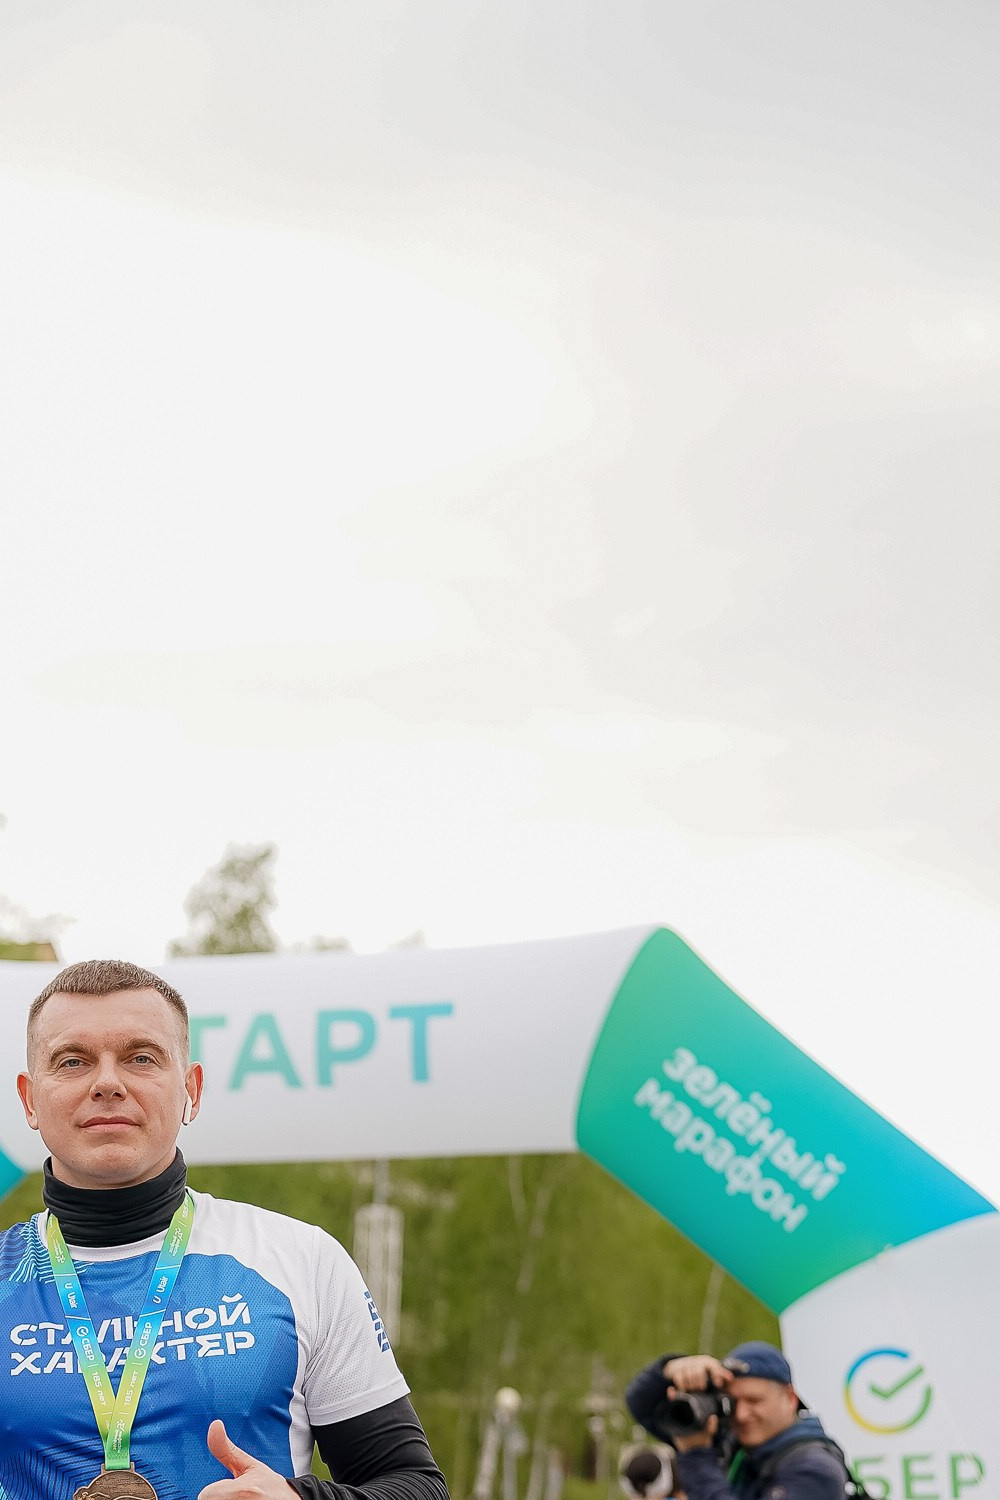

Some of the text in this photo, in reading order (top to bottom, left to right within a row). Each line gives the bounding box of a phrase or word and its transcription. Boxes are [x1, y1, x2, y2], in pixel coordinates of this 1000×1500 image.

[188, 1002, 455, 1092] ТАРТ
[661, 1046, 848, 1201] зелёный
[634, 1077, 809, 1233] марафон
[10, 1293, 252, 1346] СТЛНОЙ
[139, 1322, 153, 1347] СБЕР
[10, 1331, 256, 1376] ХААКТЕР
[82, 1338, 95, 1361] СБЕР
[92, 1371, 102, 1387] 185
[124, 1390, 134, 1406] 185
